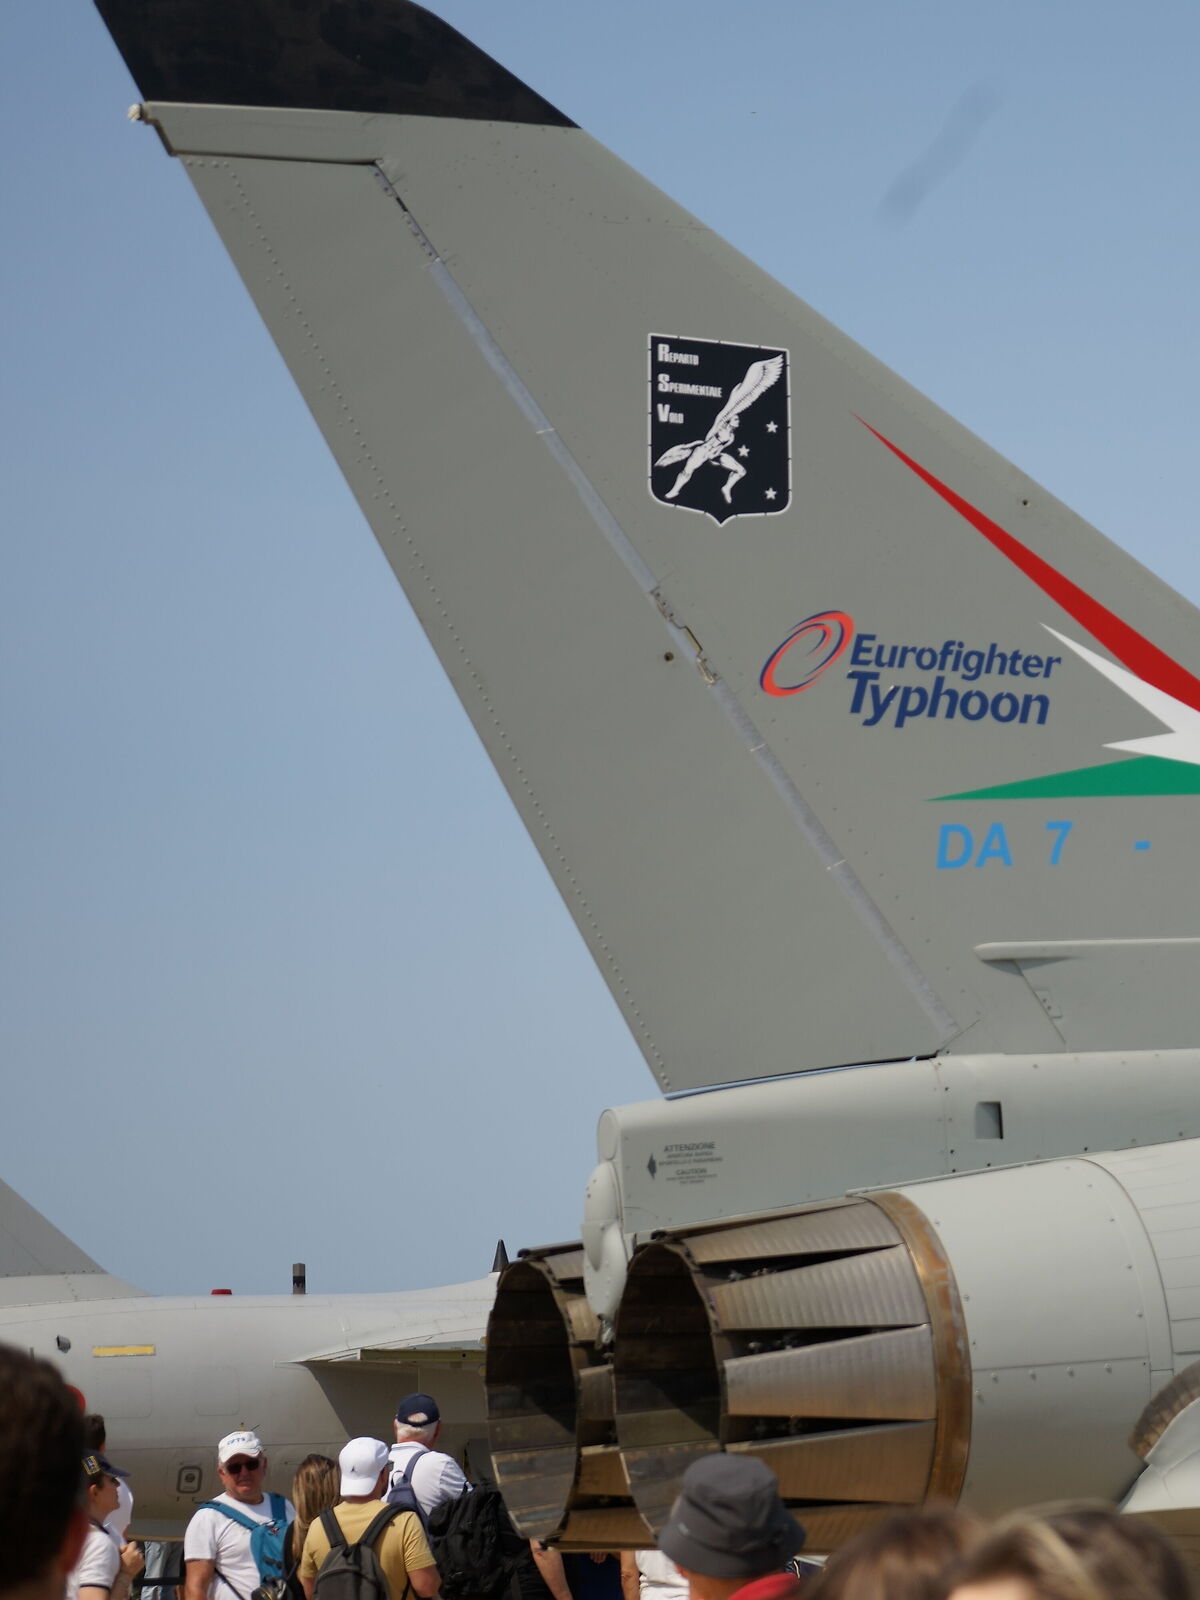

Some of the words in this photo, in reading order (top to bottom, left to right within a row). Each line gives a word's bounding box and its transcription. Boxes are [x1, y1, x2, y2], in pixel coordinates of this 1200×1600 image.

[849, 633, 1063, 682] Eurofighter
[847, 670, 1051, 729] Typhoon
[935, 822, 1014, 870] DA
[1044, 820, 1074, 865] 7
[663, 1141, 716, 1153] ATTENZIONE
